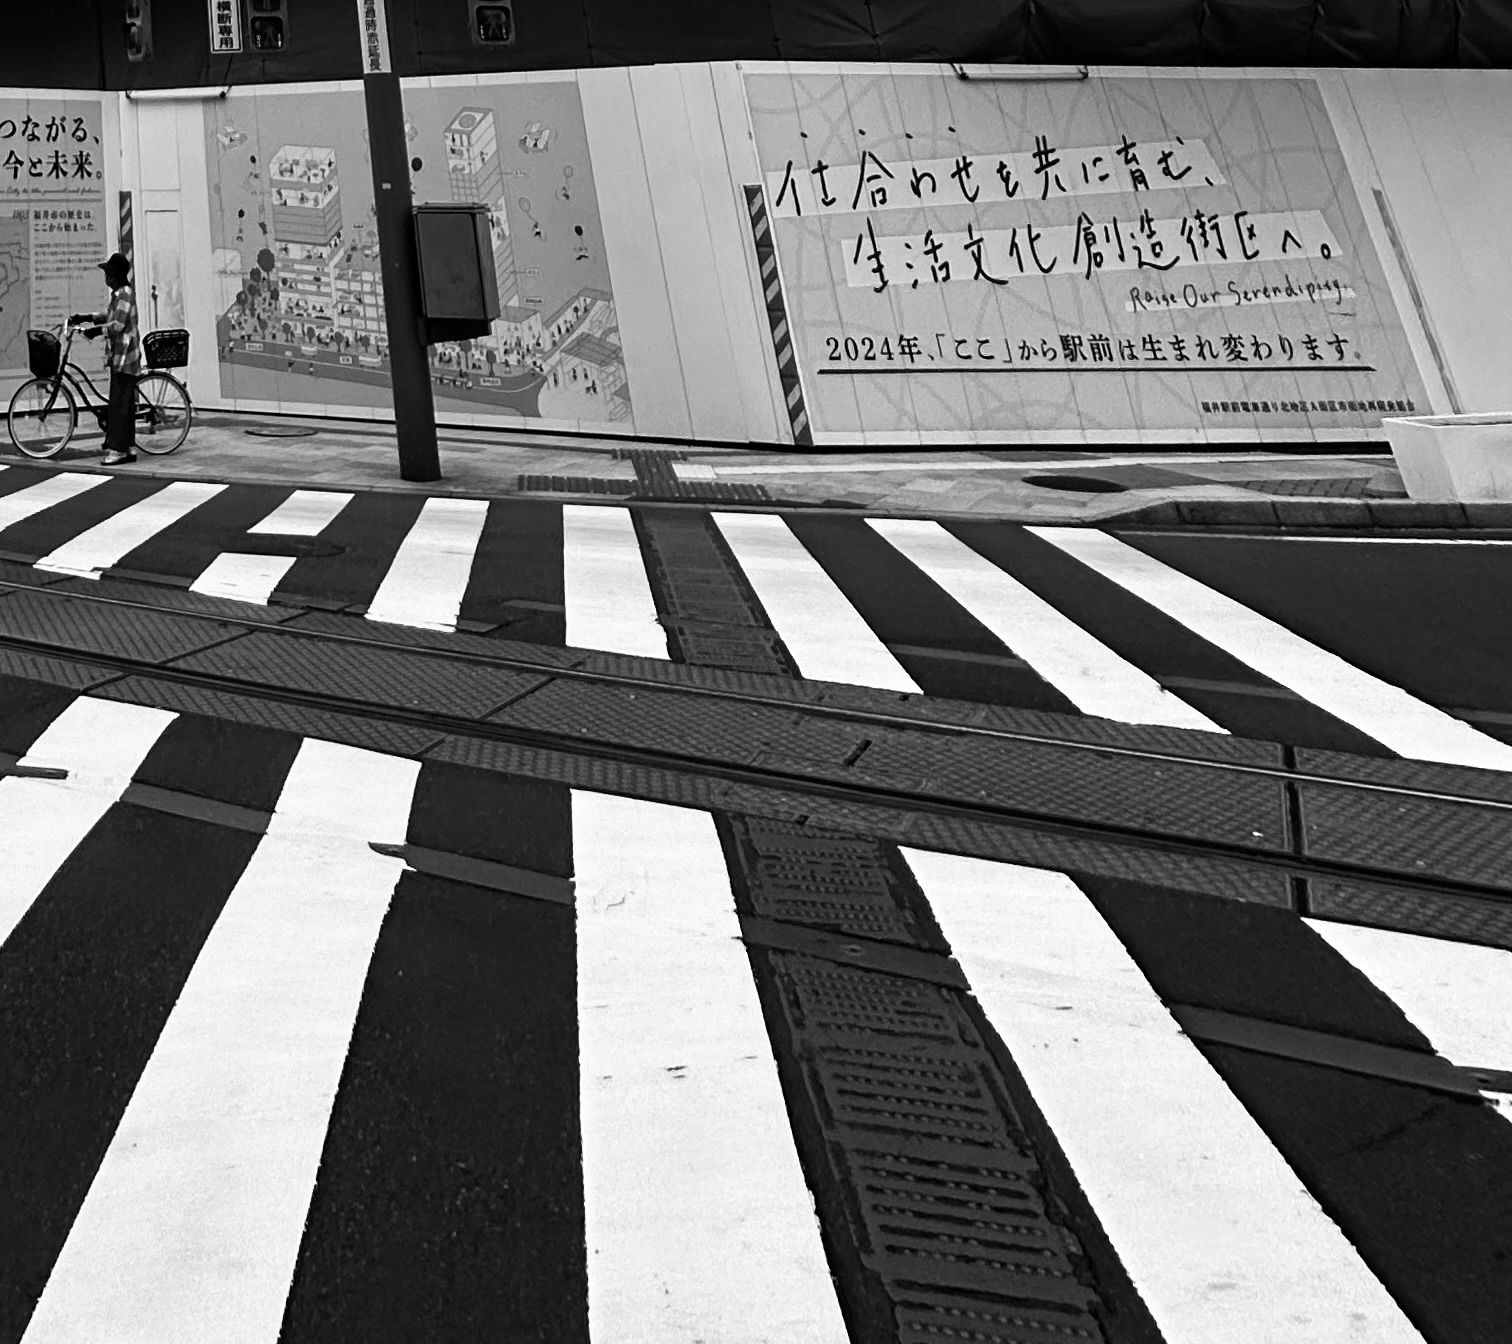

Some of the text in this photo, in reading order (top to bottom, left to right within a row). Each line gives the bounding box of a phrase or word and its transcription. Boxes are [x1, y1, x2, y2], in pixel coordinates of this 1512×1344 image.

[776, 134, 1216, 216] 仕合わせを共に育む、
[854, 210, 1332, 292] 生活文化創造街区へ。
[1183, 283, 1221, 308] Our
[826, 333, 1362, 363] 2024年、「ここ」から駅前は生まれ変わります。
